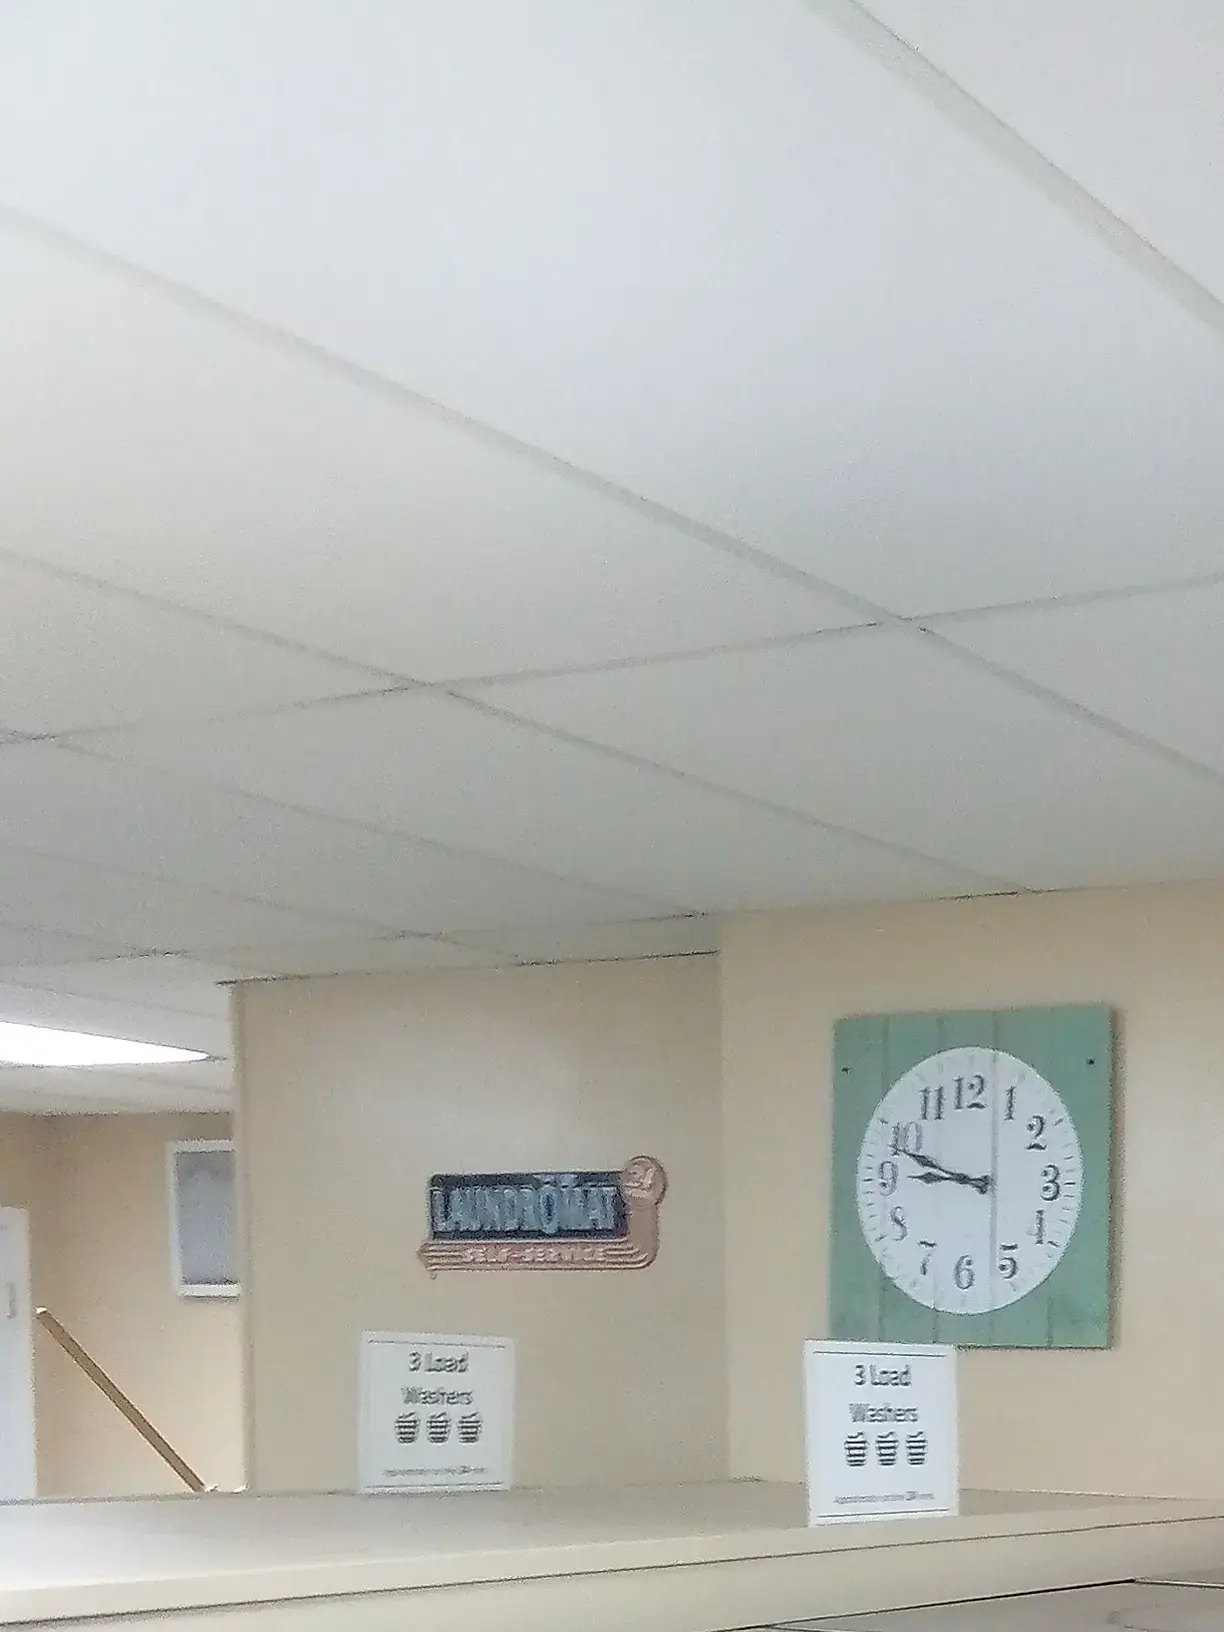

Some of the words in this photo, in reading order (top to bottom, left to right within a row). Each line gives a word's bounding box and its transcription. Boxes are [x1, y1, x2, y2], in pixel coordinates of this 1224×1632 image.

[919, 1086, 945, 1120] 11
[954, 1074, 987, 1110] 12
[1004, 1086, 1018, 1120] 1
[890, 1121, 923, 1156] 10
[1025, 1115, 1048, 1151] 2
[877, 1161, 899, 1196] 9
[1040, 1165, 1061, 1201] 3
[431, 1184, 618, 1234] LAUNDROMAT
[917, 1239, 938, 1277] 7
[954, 1255, 975, 1290] 6
[999, 1243, 1019, 1280] 5
[408, 1351, 422, 1372] 3
[424, 1351, 470, 1373] Load
[854, 1363, 866, 1386] 3
[869, 1363, 912, 1386] Load
[848, 1402, 919, 1423] Washers
